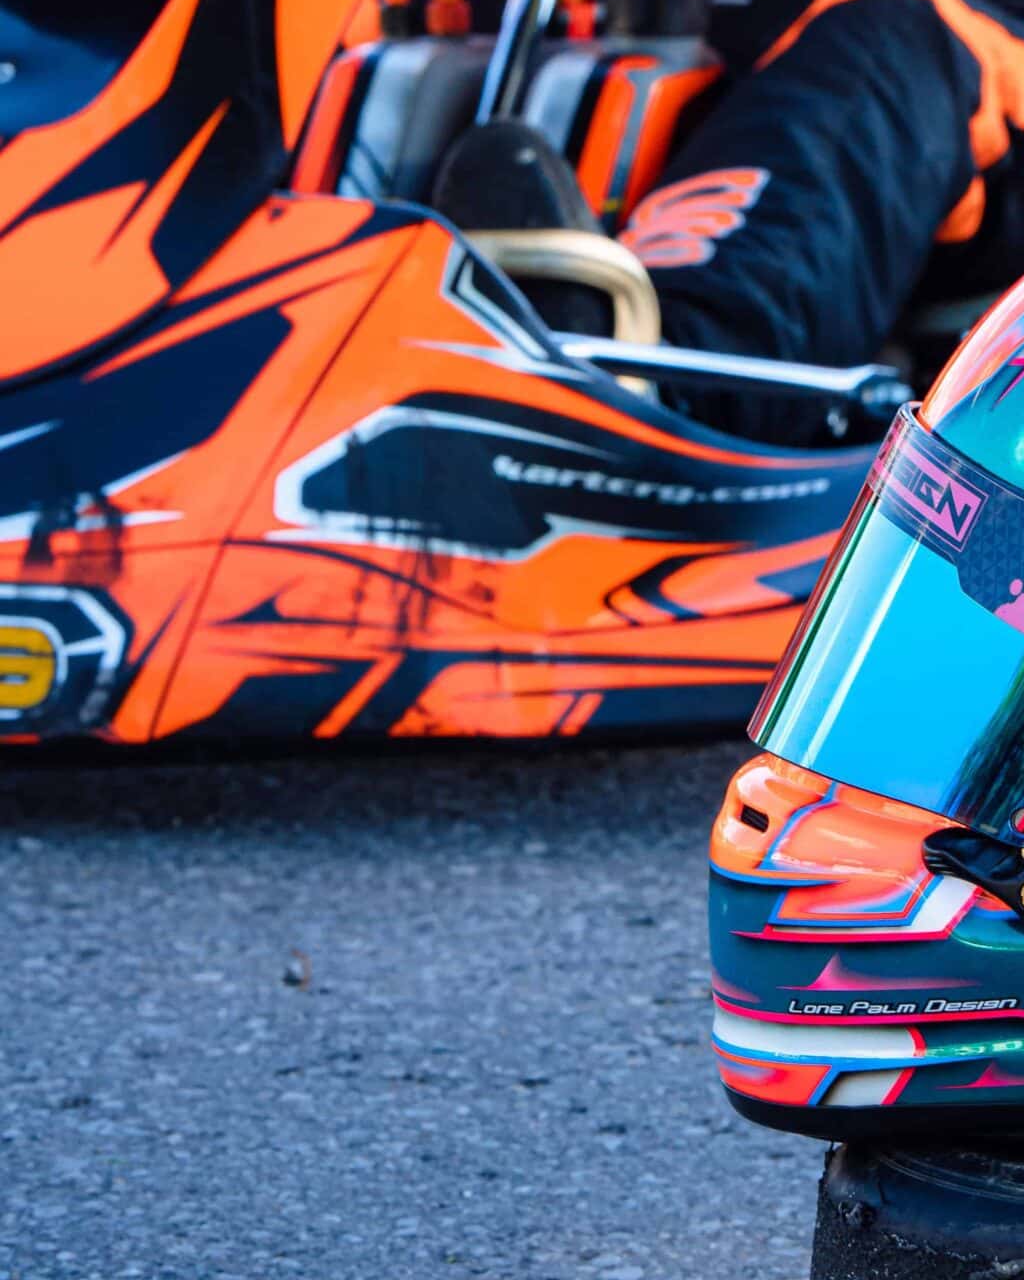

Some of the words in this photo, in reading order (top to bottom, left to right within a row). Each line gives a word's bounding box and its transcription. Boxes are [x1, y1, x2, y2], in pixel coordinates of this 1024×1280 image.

[892, 453, 971, 537] SIGN
[788, 1000, 843, 1014] Lone
[850, 1001, 916, 1014] Palm
[925, 998, 1017, 1012] Design
